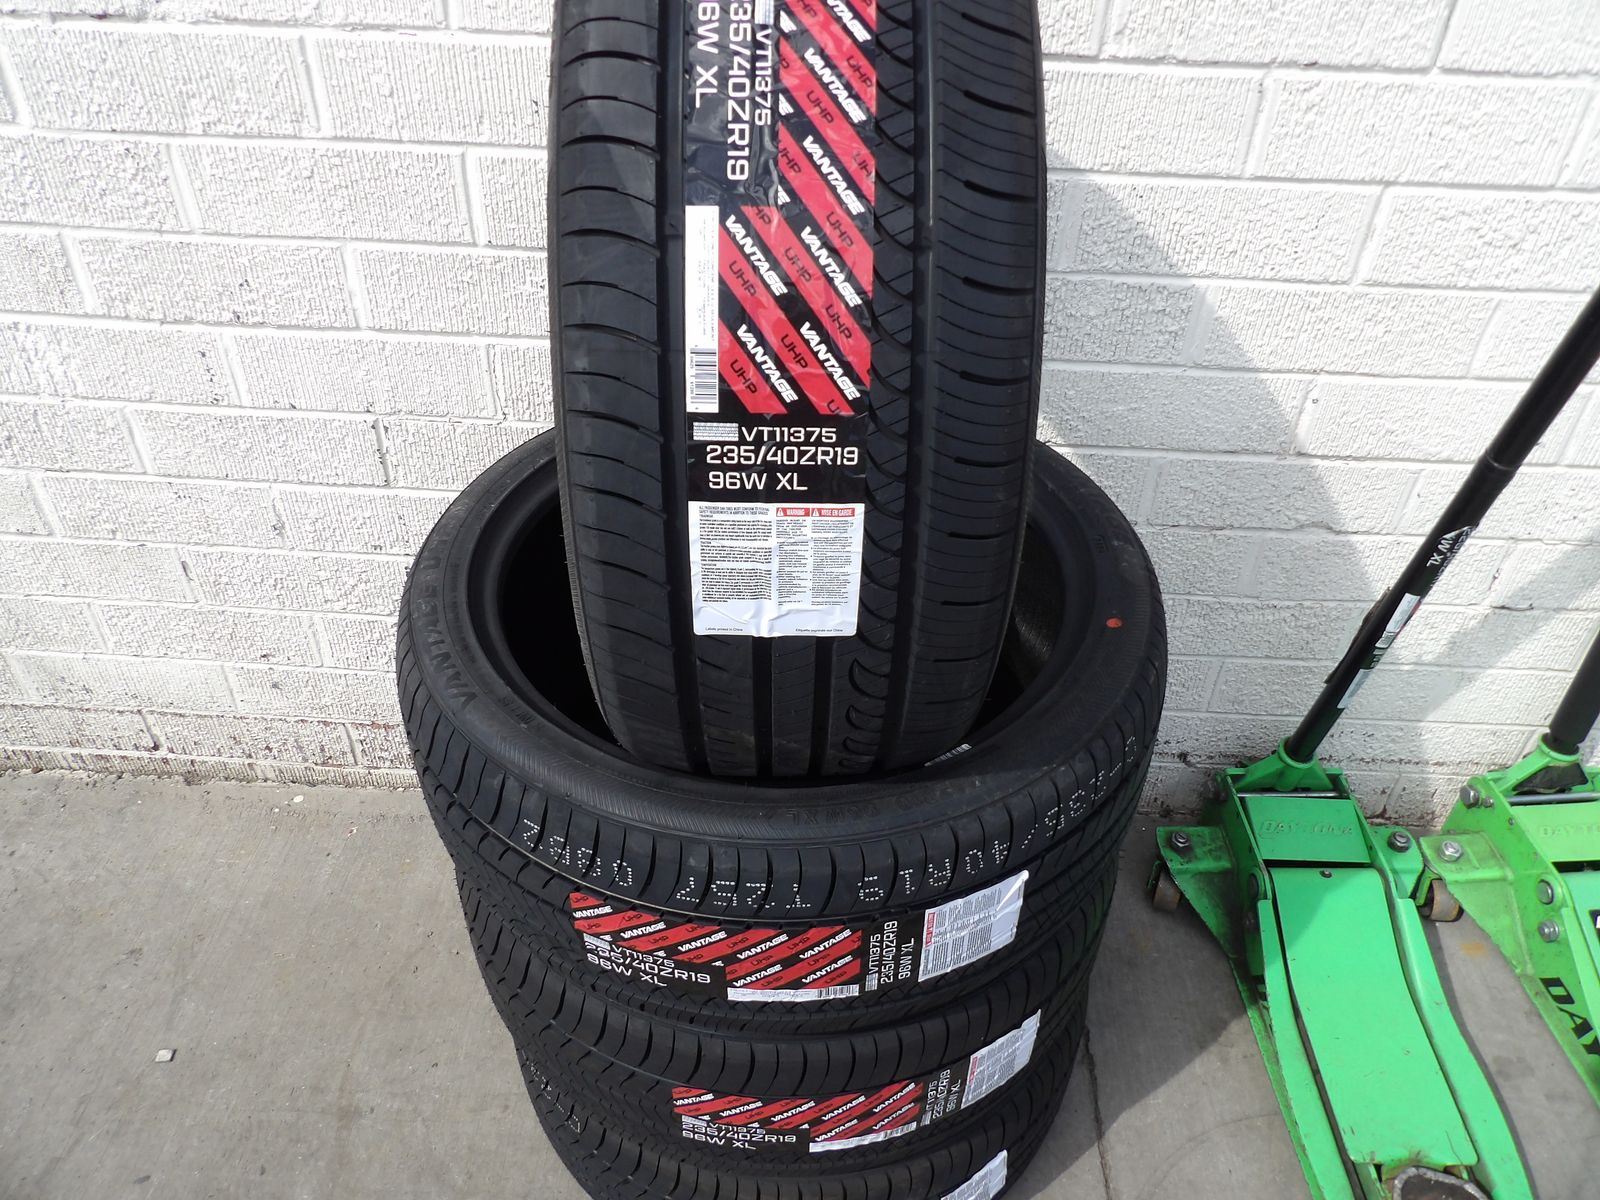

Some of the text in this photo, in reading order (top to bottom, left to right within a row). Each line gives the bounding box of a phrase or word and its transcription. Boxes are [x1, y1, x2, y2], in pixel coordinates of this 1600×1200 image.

[826, 0, 872, 42] TAGE
[696, 0, 719, 108] 6W XL
[755, 28, 772, 126] VT11375
[803, 47, 867, 124] VANTAGE
[846, 55, 873, 88] UHP
[727, 0, 752, 181] 35/40ZR19
[806, 90, 834, 125] UHP
[802, 135, 865, 216] VANTAGE
[826, 211, 854, 249] UHP
[725, 214, 788, 297] VANTAGE
[784, 247, 812, 283] UHP
[800, 226, 863, 308] VANTAGE
[729, 260, 757, 297] UHP
[825, 304, 852, 340] UHP
[736, 324, 799, 404] VANTAGE
[780, 333, 808, 370] UHP
[800, 321, 861, 401] VANTAGE
[730, 359, 758, 395] UHP
[741, 426, 837, 443] VT11375
[705, 445, 859, 466] 235/40ZR19
[708, 471, 808, 491] 96W XL
[1426, 552, 1445, 567] XL
[573, 905, 613, 918] VANTAGE
[620, 921, 667, 939] VANTAGE
[678, 930, 728, 952] VANTAGE
[726, 936, 750, 950] UHP
[786, 936, 810, 950] UHP
[799, 928, 853, 959] VANTAGE
[736, 933, 789, 960] VANTAGE
[869, 934, 881, 975] VT11375
[880, 920, 898, 985] 235/40ZR19
[898, 938, 915, 980] 96W XL
[640, 972, 668, 987] XL
[732, 964, 783, 987] VANTAGE
[802, 955, 854, 983] VANTAGE
[673, 1093, 714, 1106] VANTAGE
[719, 1101, 763, 1117] VANTAGE
[771, 1100, 816, 1122] VANTAGE
[822, 1094, 866, 1121] VANTAGE
[872, 1082, 916, 1113] VANTAGE
[815, 1118, 859, 1142] VANTAGE
[872, 1102, 915, 1130] VANTAGE
[732, 1140, 757, 1150] XL
